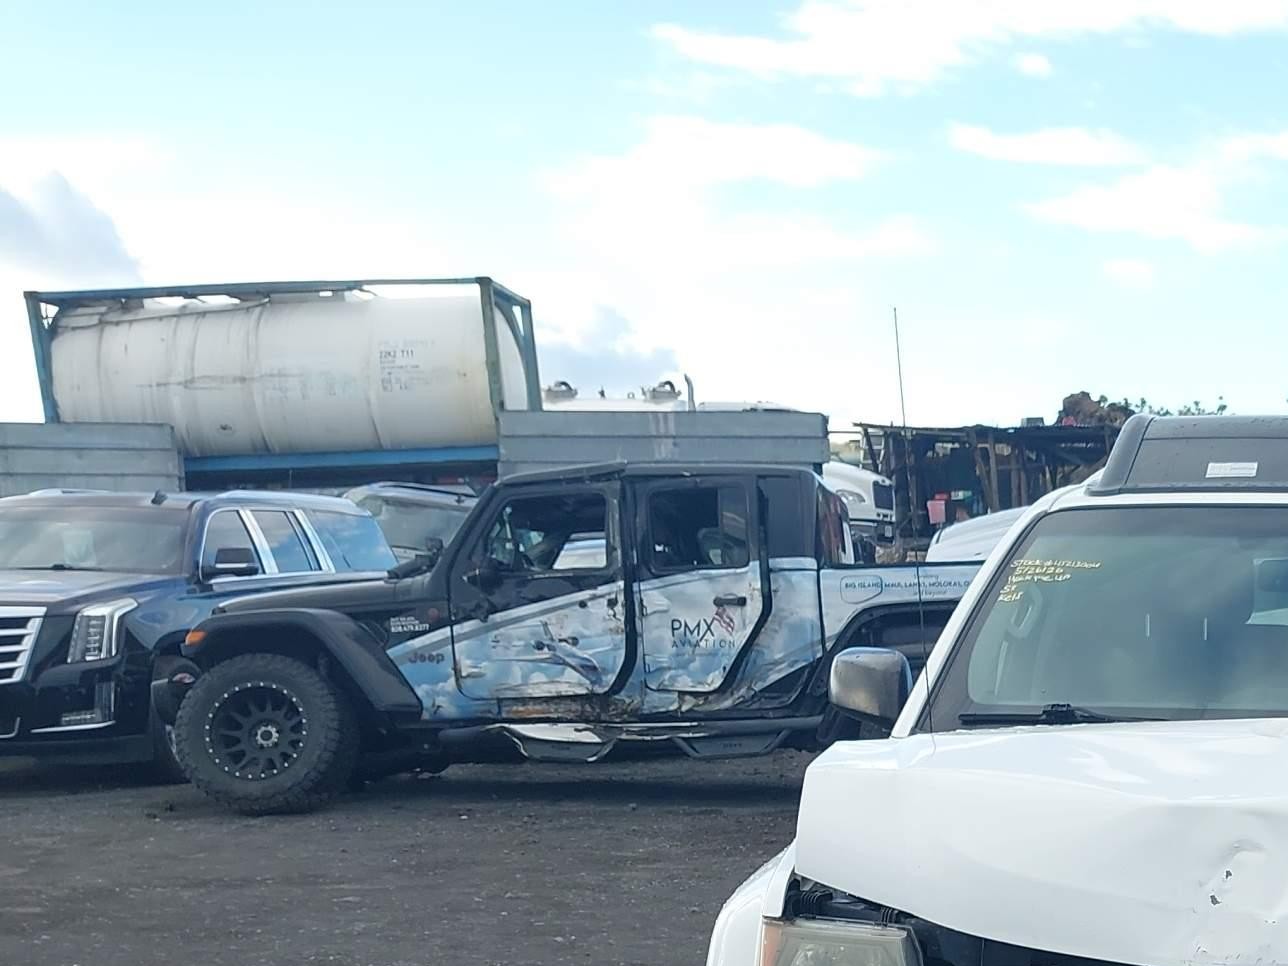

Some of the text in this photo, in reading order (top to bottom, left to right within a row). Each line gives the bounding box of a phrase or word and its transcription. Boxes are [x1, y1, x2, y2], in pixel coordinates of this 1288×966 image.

[671, 616, 716, 642] PMX
[671, 639, 736, 649] AVIATION
[408, 651, 445, 664] Jeep
